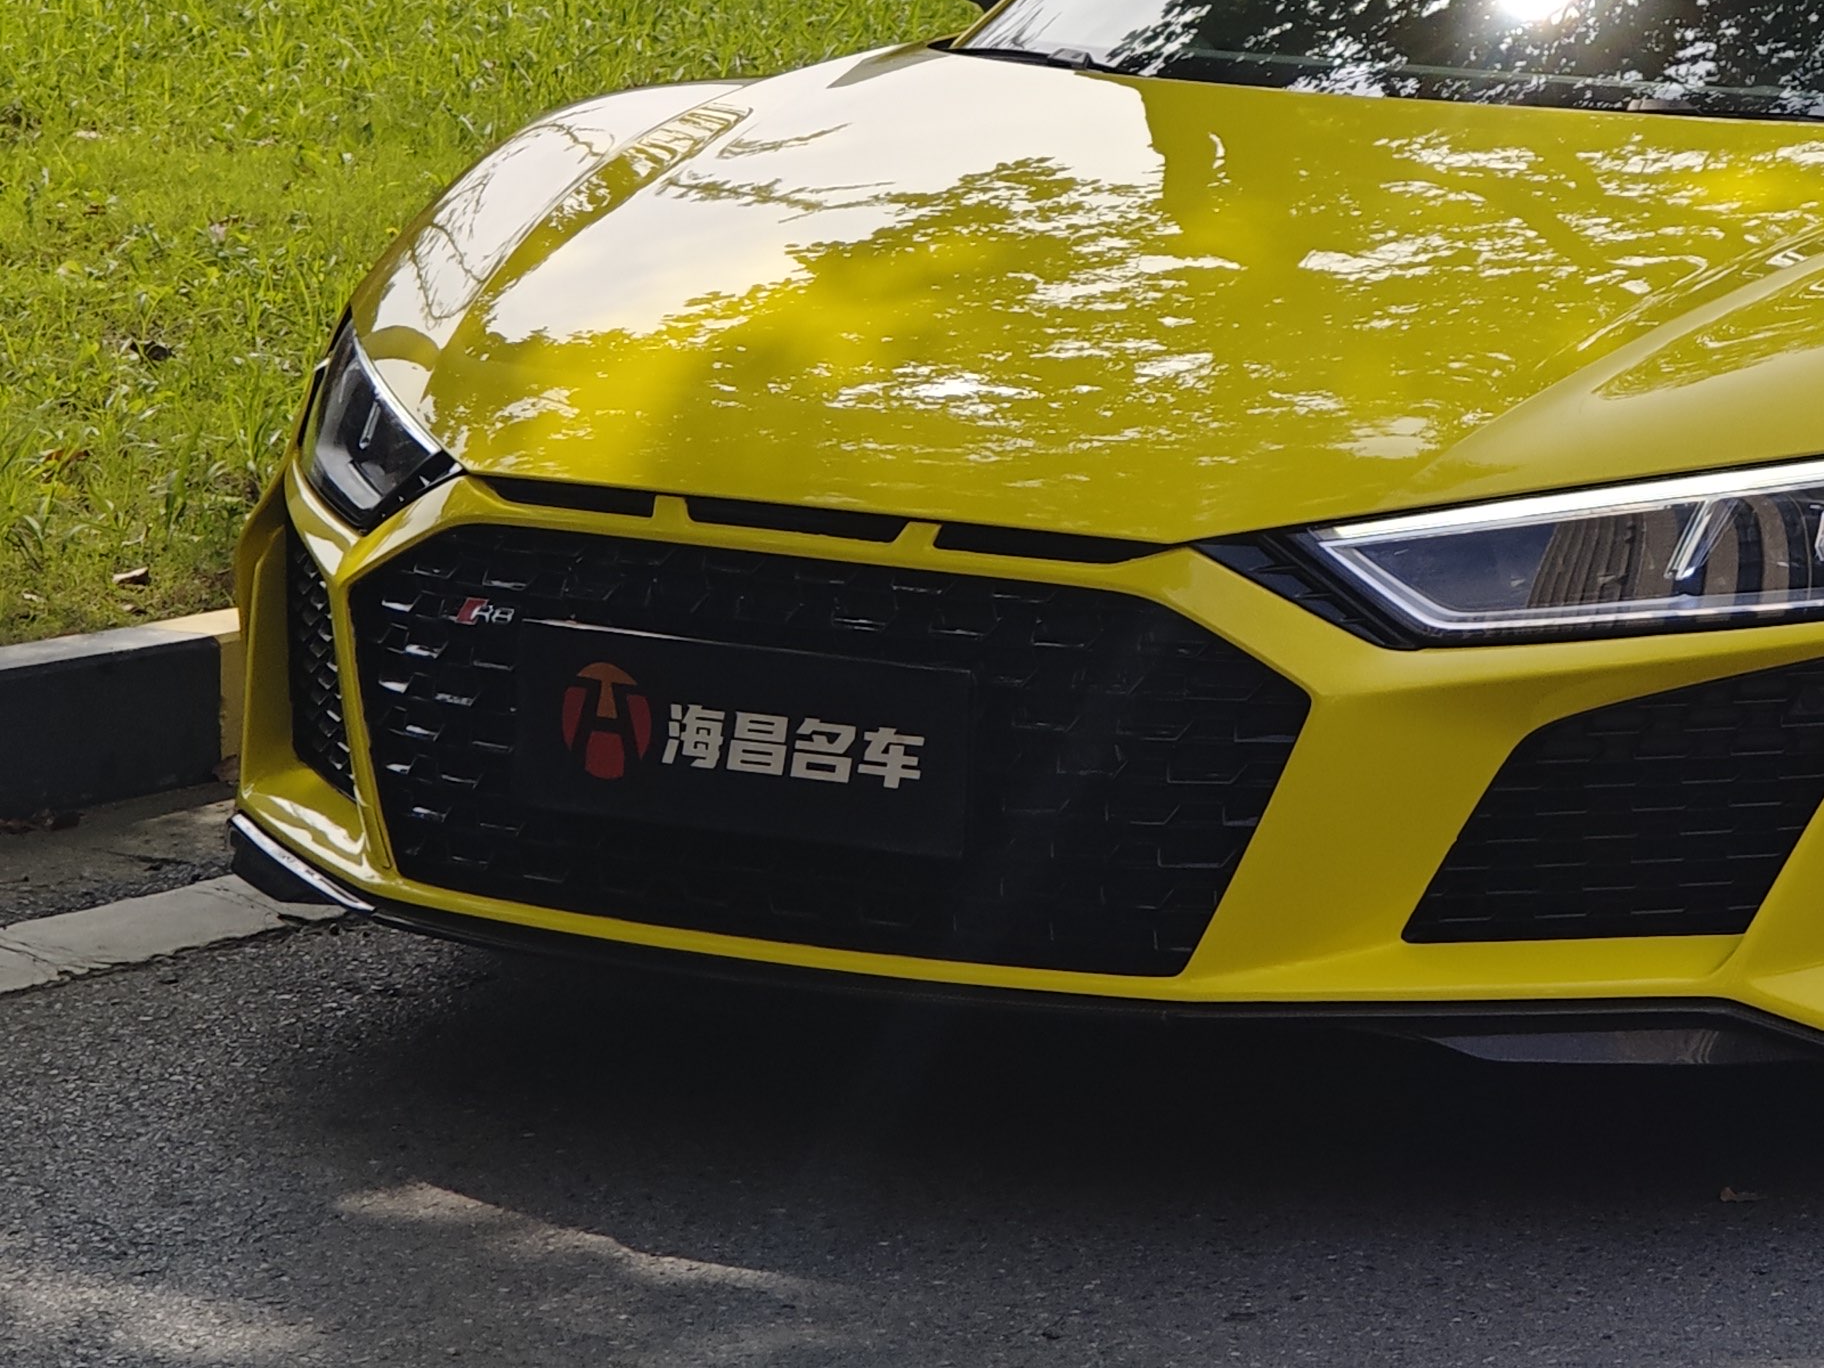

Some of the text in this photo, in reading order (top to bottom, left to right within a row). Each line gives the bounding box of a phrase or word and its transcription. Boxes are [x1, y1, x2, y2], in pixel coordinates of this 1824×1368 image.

[470, 604, 515, 624] R8
[661, 704, 925, 789] 海昌名车
